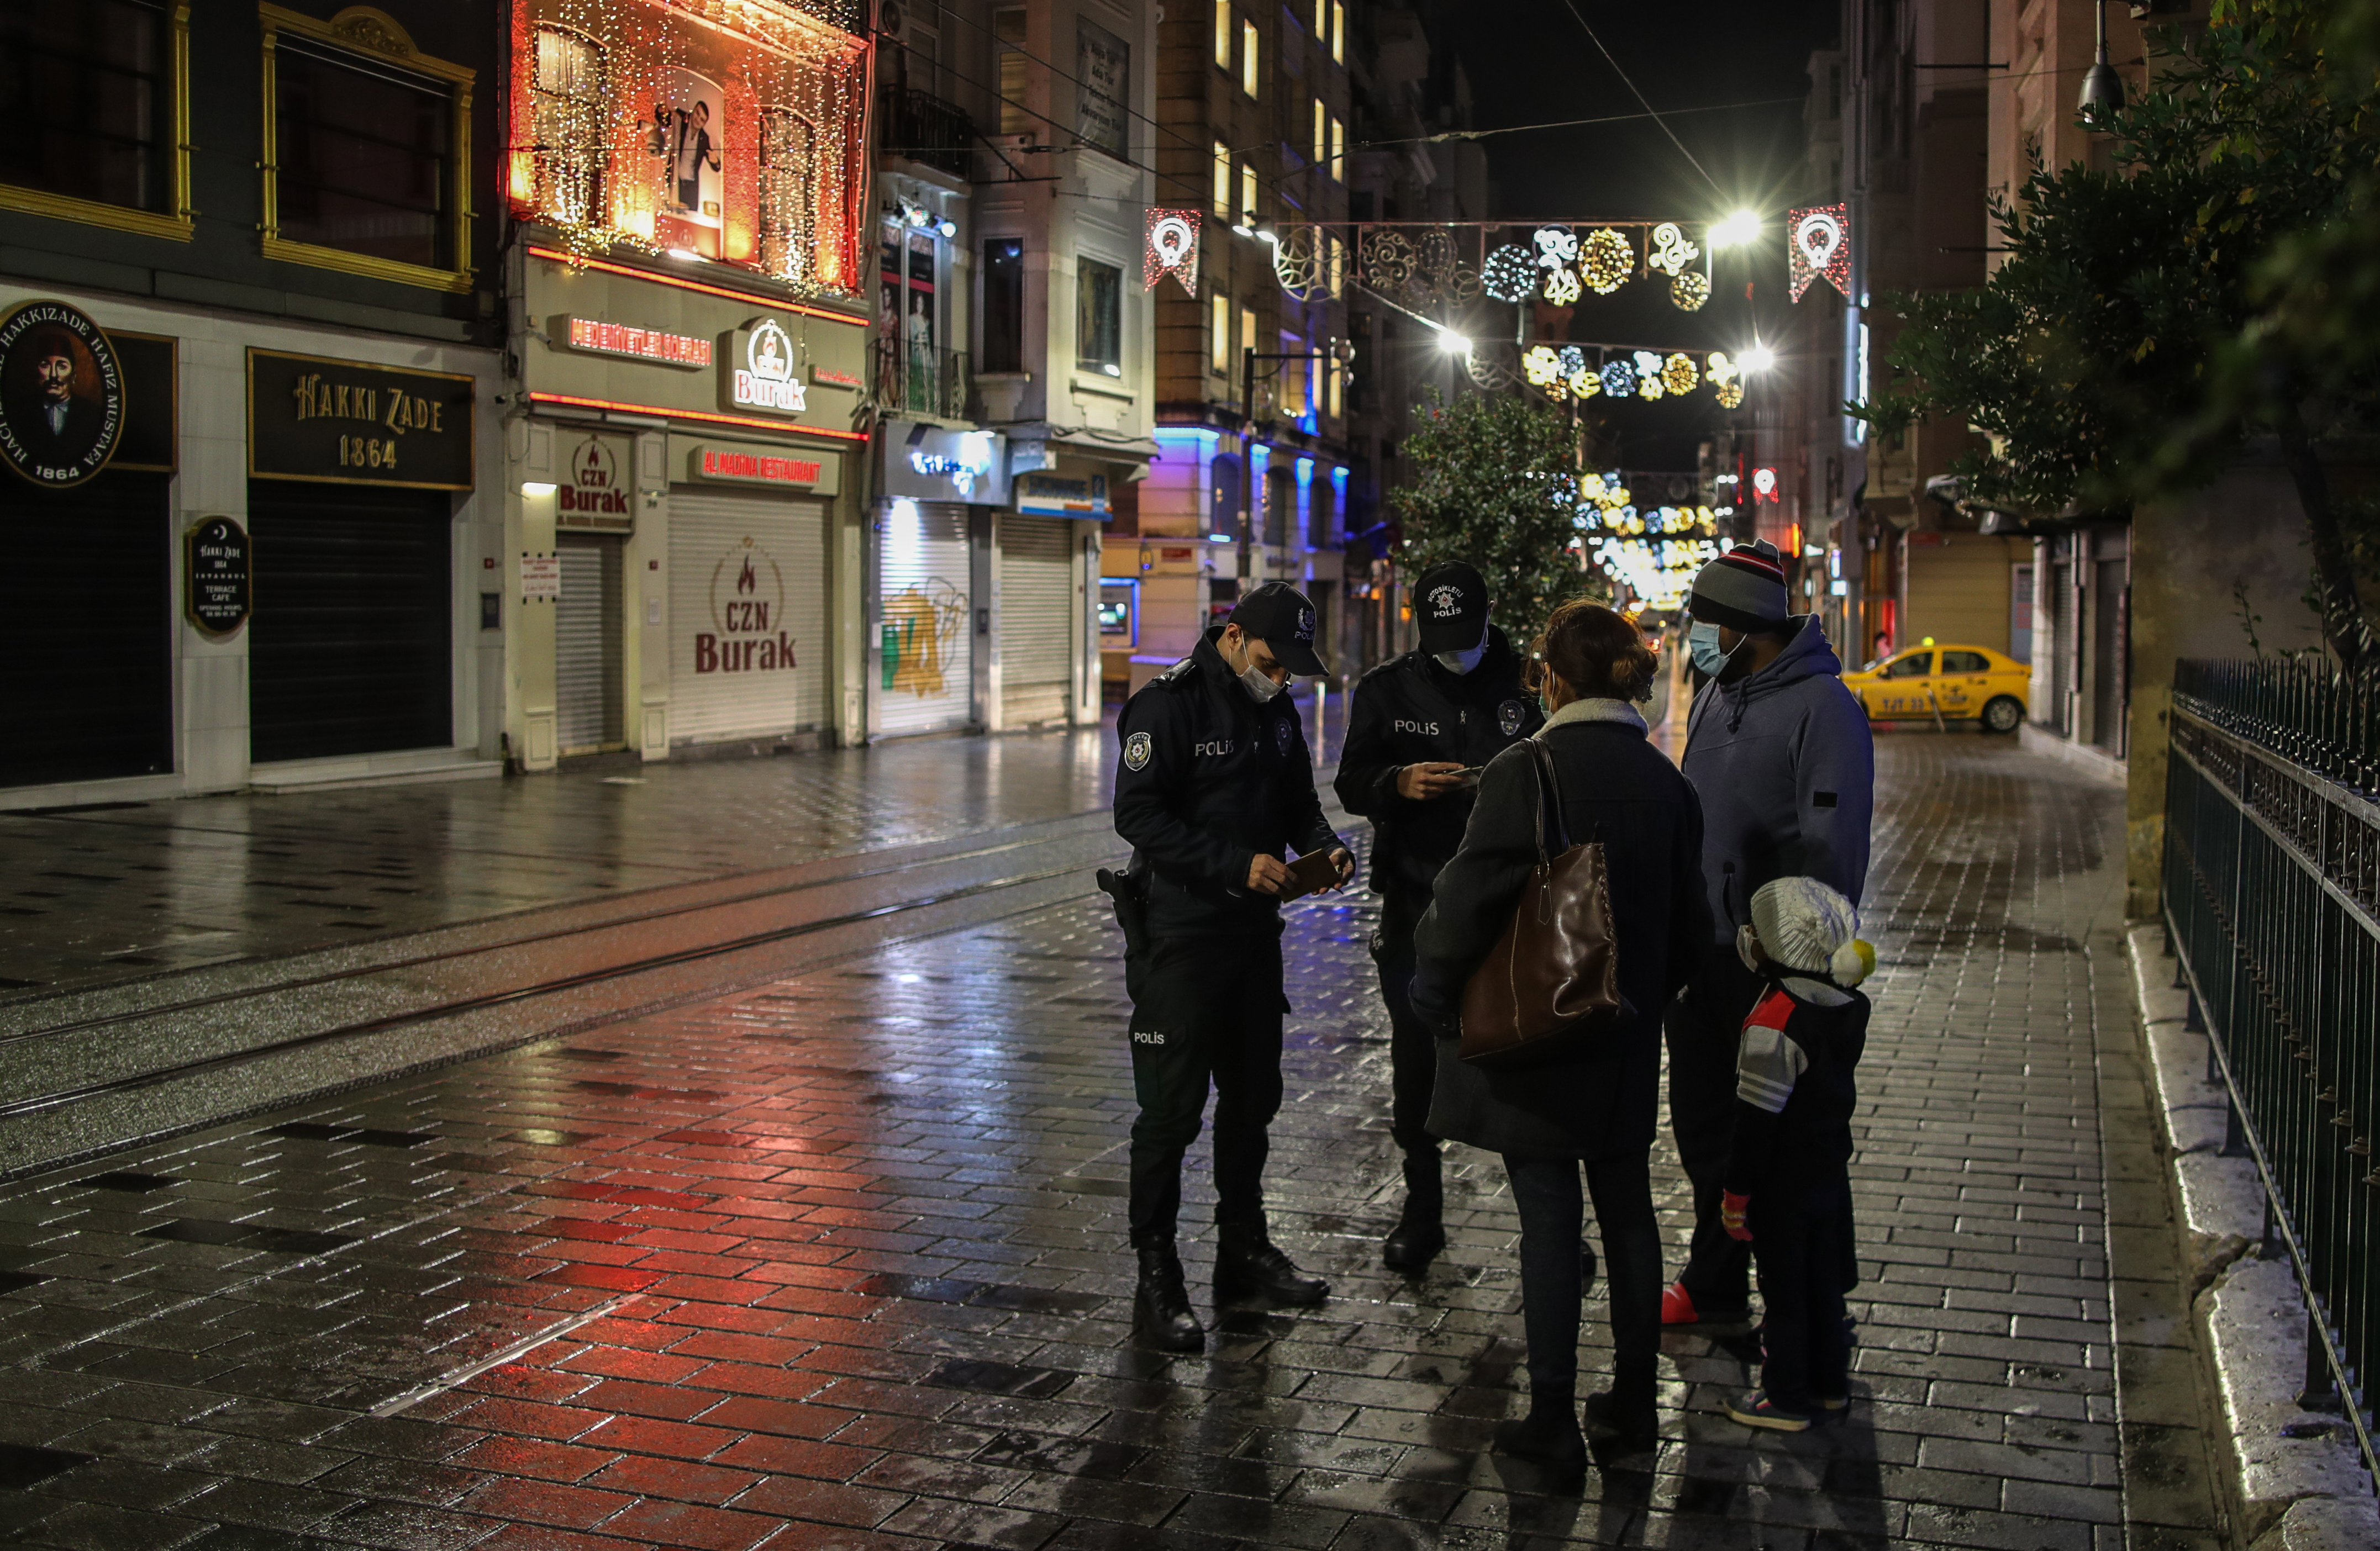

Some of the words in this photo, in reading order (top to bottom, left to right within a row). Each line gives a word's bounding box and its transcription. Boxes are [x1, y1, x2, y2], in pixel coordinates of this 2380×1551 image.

[0, 307, 91, 347] HAKKIZADE
[90, 337, 117, 389] HAFIZ
[293, 373, 377, 421] HAKKI
[385, 387, 443, 435] ZADE
[735, 369, 807, 412] Burak
[83, 394, 118, 466] MUSTAFA
[339, 434, 397, 469] 1864
[703, 450, 718, 474] AL
[760, 456, 822, 484] RESTAURANT
[35, 465, 80, 480] 1864
[582, 469, 607, 487] CZN
[560, 484, 629, 513] Burak
[726, 601, 769, 631] CZN
[696, 631, 797, 673] Burak
